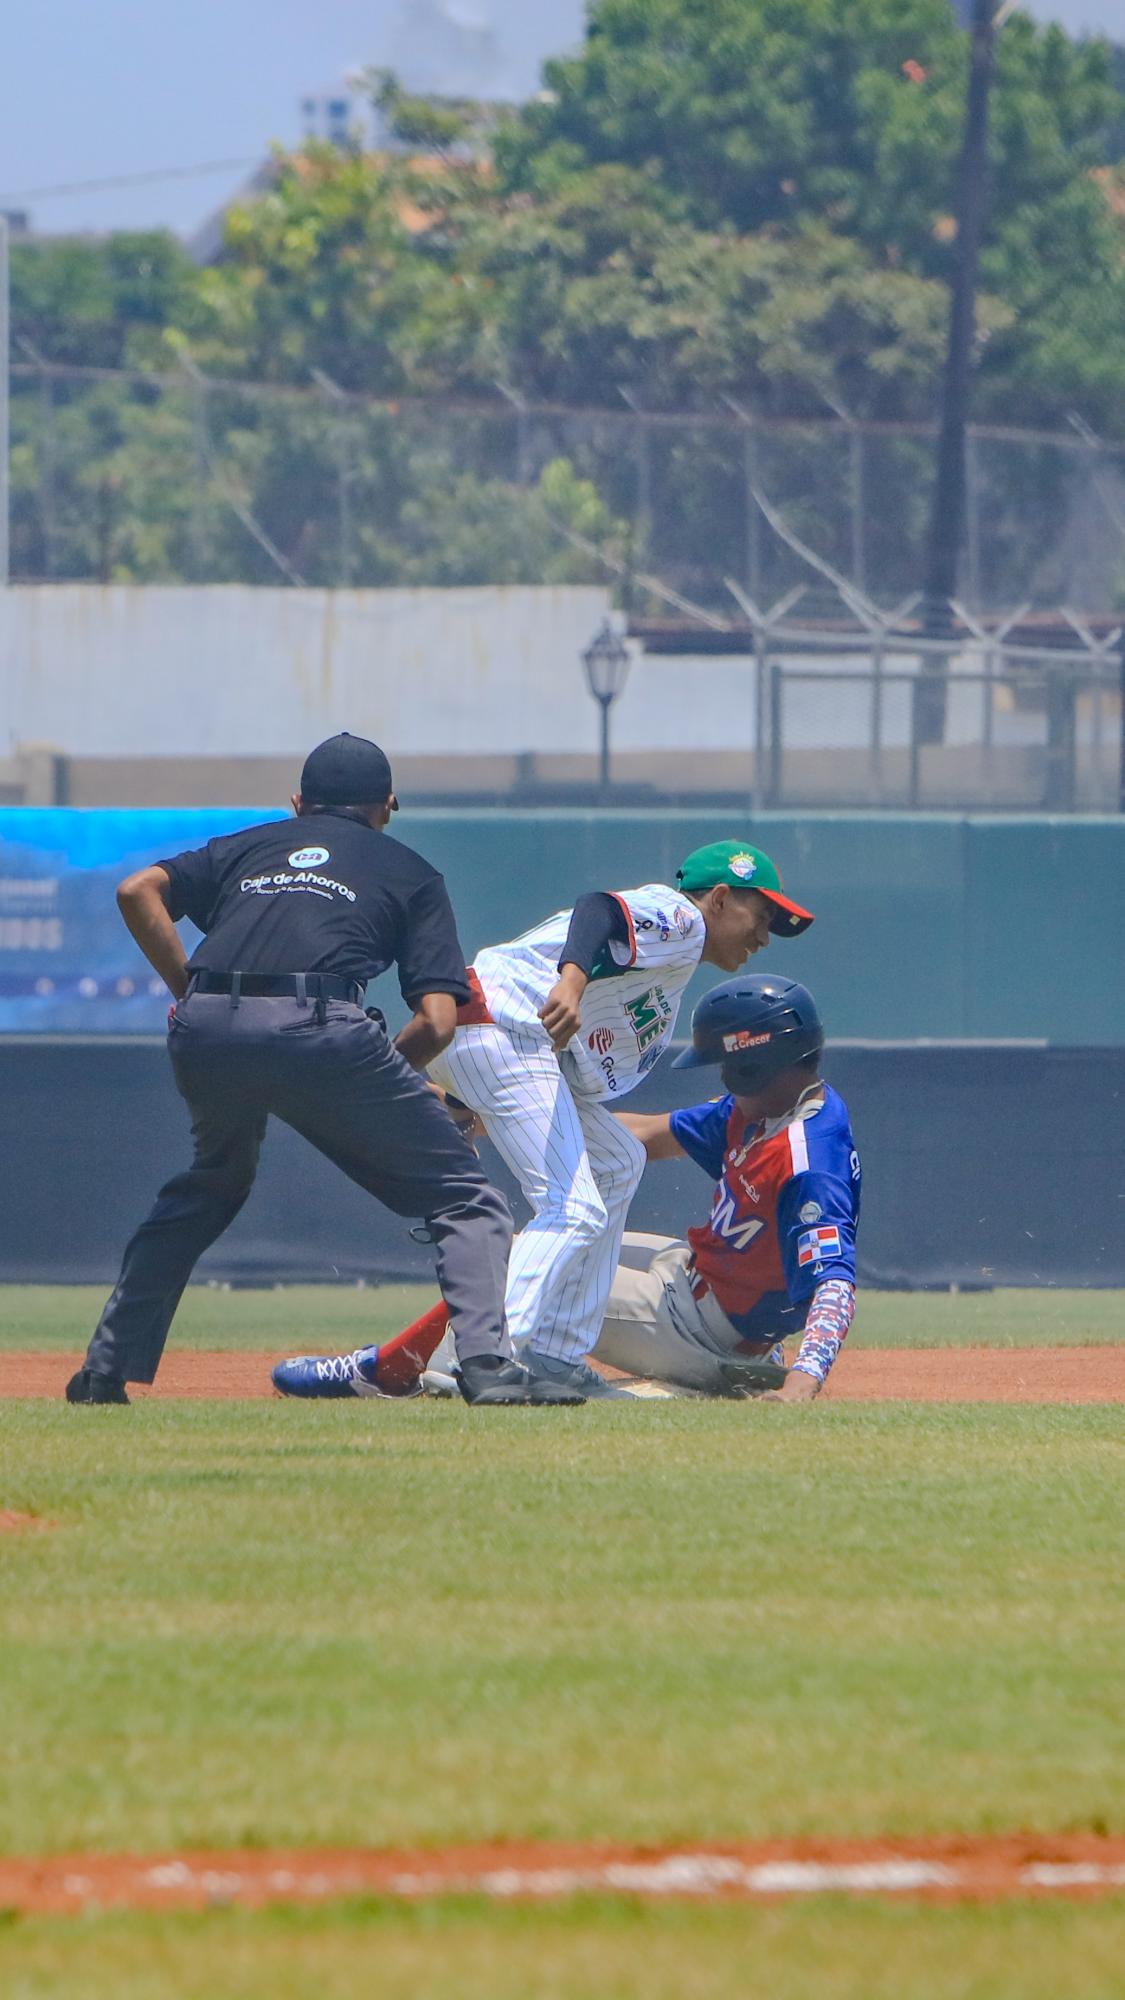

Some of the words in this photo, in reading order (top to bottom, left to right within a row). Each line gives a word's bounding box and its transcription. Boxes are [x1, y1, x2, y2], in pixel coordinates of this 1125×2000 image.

[240, 876, 272, 892] Caja
[273, 873, 294, 885] de
[293, 872, 358, 902] Ahorros
[659, 1002, 673, 1016] DE
